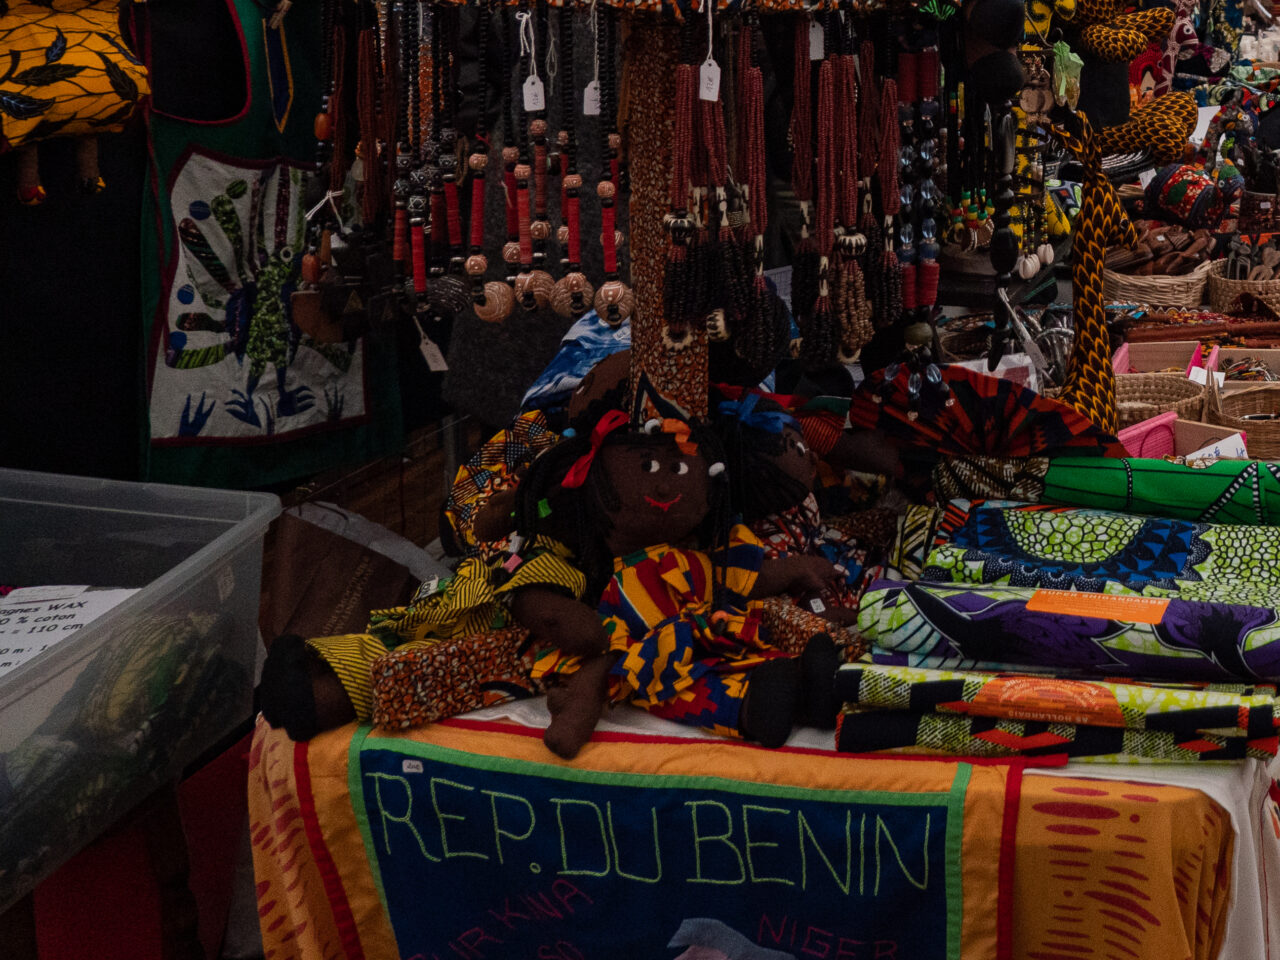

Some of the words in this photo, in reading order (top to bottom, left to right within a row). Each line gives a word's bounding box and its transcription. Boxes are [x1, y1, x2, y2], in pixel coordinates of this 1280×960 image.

[48, 601, 88, 611] WAX
[34, 613, 76, 623] coton
[28, 624, 58, 634] 110
[62, 623, 83, 631] cm
[365, 771, 542, 875] REP.
[549, 796, 662, 884] DU
[684, 798, 932, 897] BENIN
[756, 913, 900, 960] NIGER
